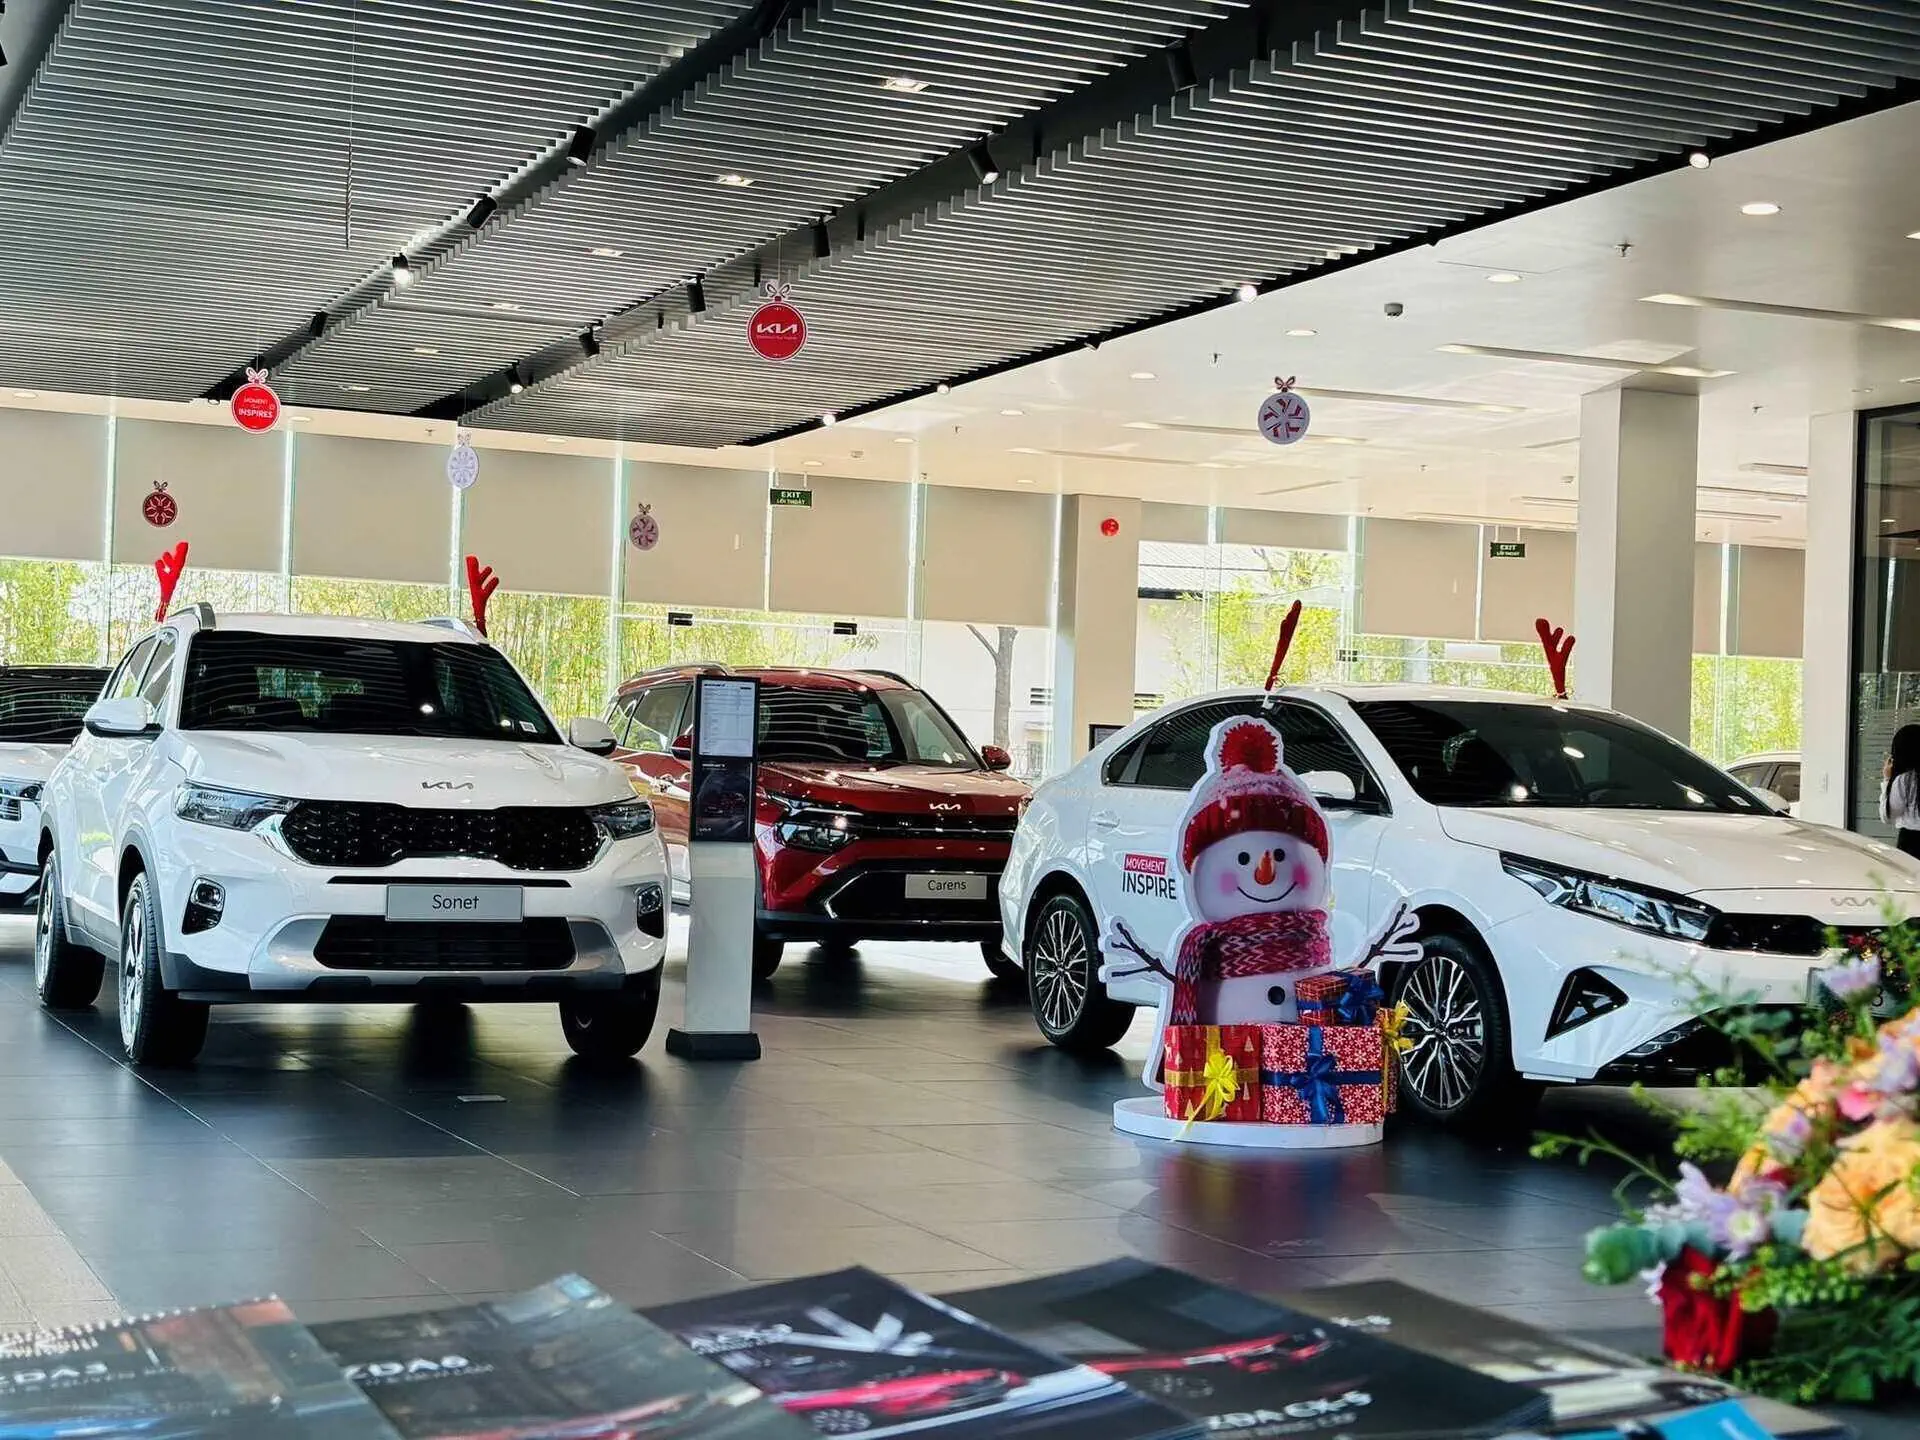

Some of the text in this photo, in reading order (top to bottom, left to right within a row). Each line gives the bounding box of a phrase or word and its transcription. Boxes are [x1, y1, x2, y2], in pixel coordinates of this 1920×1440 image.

[238, 408, 273, 418] INSPIRES
[1126, 856, 1165, 873] MOVEMENT
[927, 880, 967, 890] Carens
[1122, 871, 1177, 900] INSPIRE
[431, 894, 480, 910] Sonet
